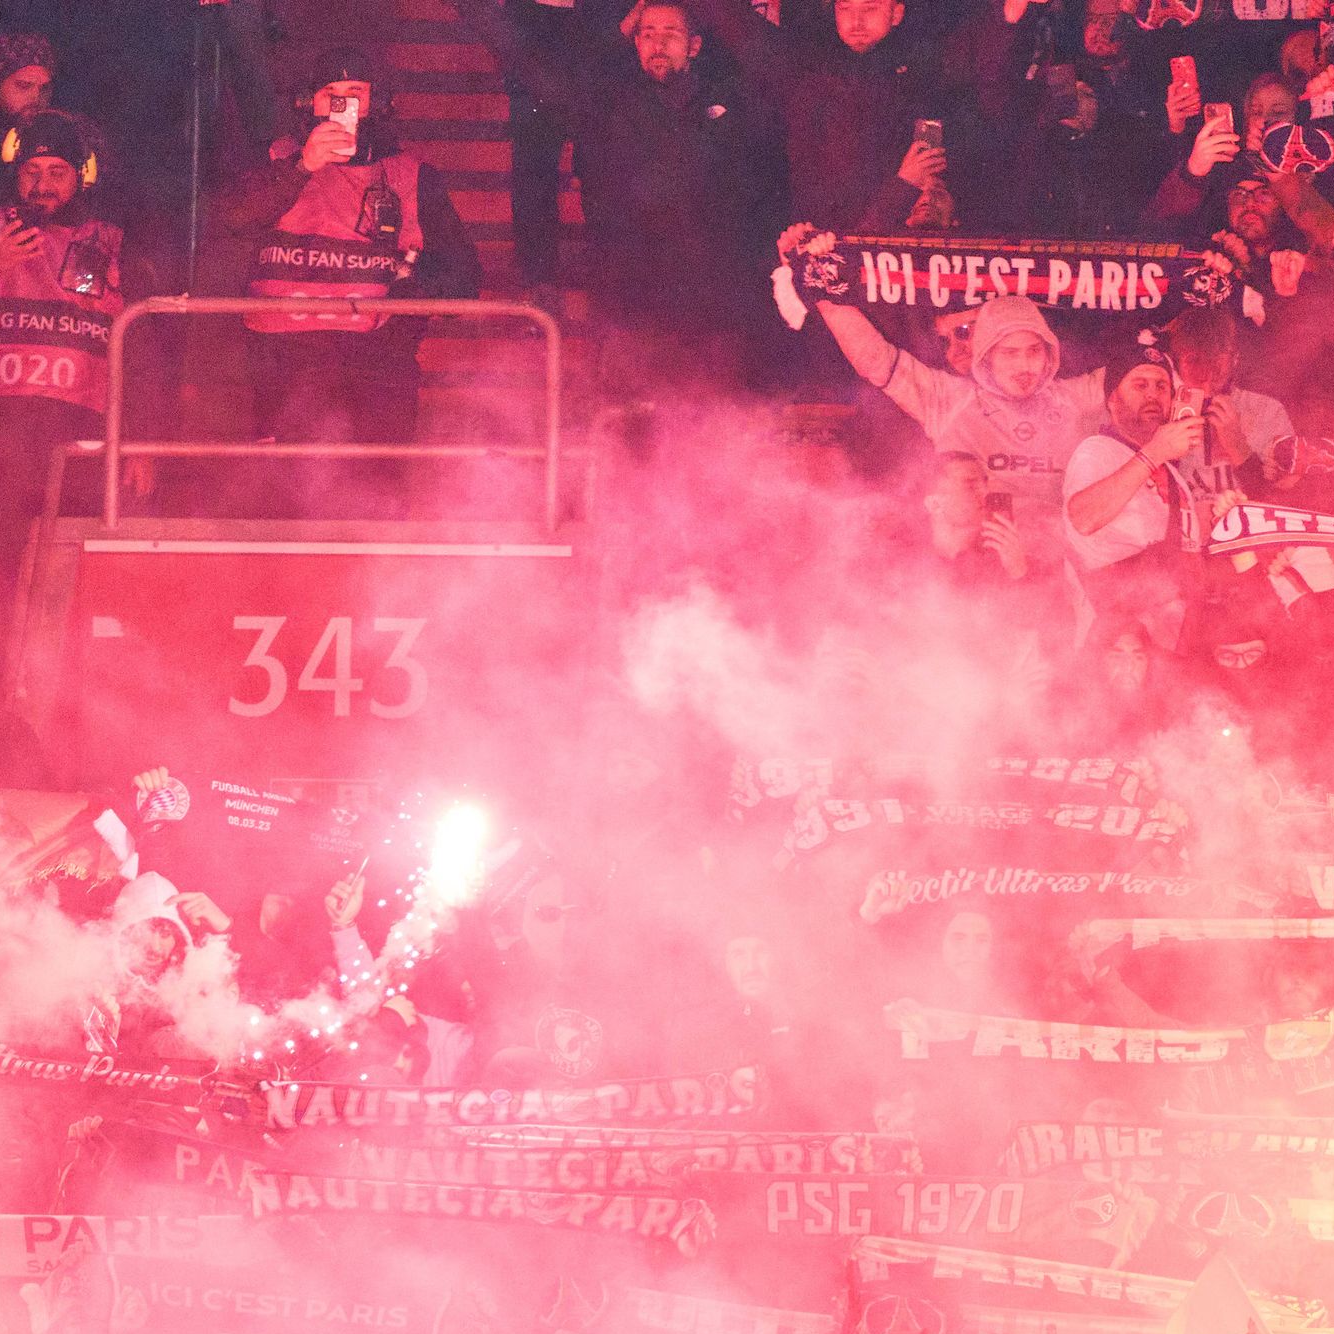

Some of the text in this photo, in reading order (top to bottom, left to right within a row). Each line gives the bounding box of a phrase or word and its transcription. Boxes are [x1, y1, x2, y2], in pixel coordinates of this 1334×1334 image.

[306, 249, 344, 269] FAN
[861, 251, 916, 306] ICI
[1046, 257, 1165, 311] PARIS
[18, 311, 55, 330] FAN
[0, 354, 76, 389] 020
[987, 453, 1064, 474] OPEL
[228, 615, 429, 719] 343
[224, 798, 279, 817] MÜNCHEN
[78, 1053, 180, 1091] Paris
[589, 1064, 758, 1120] PARIS
[768, 1181, 1025, 1235] PSG 1970
[201, 1287, 296, 1319] C'EST
[305, 1297, 409, 1328] PARIS
